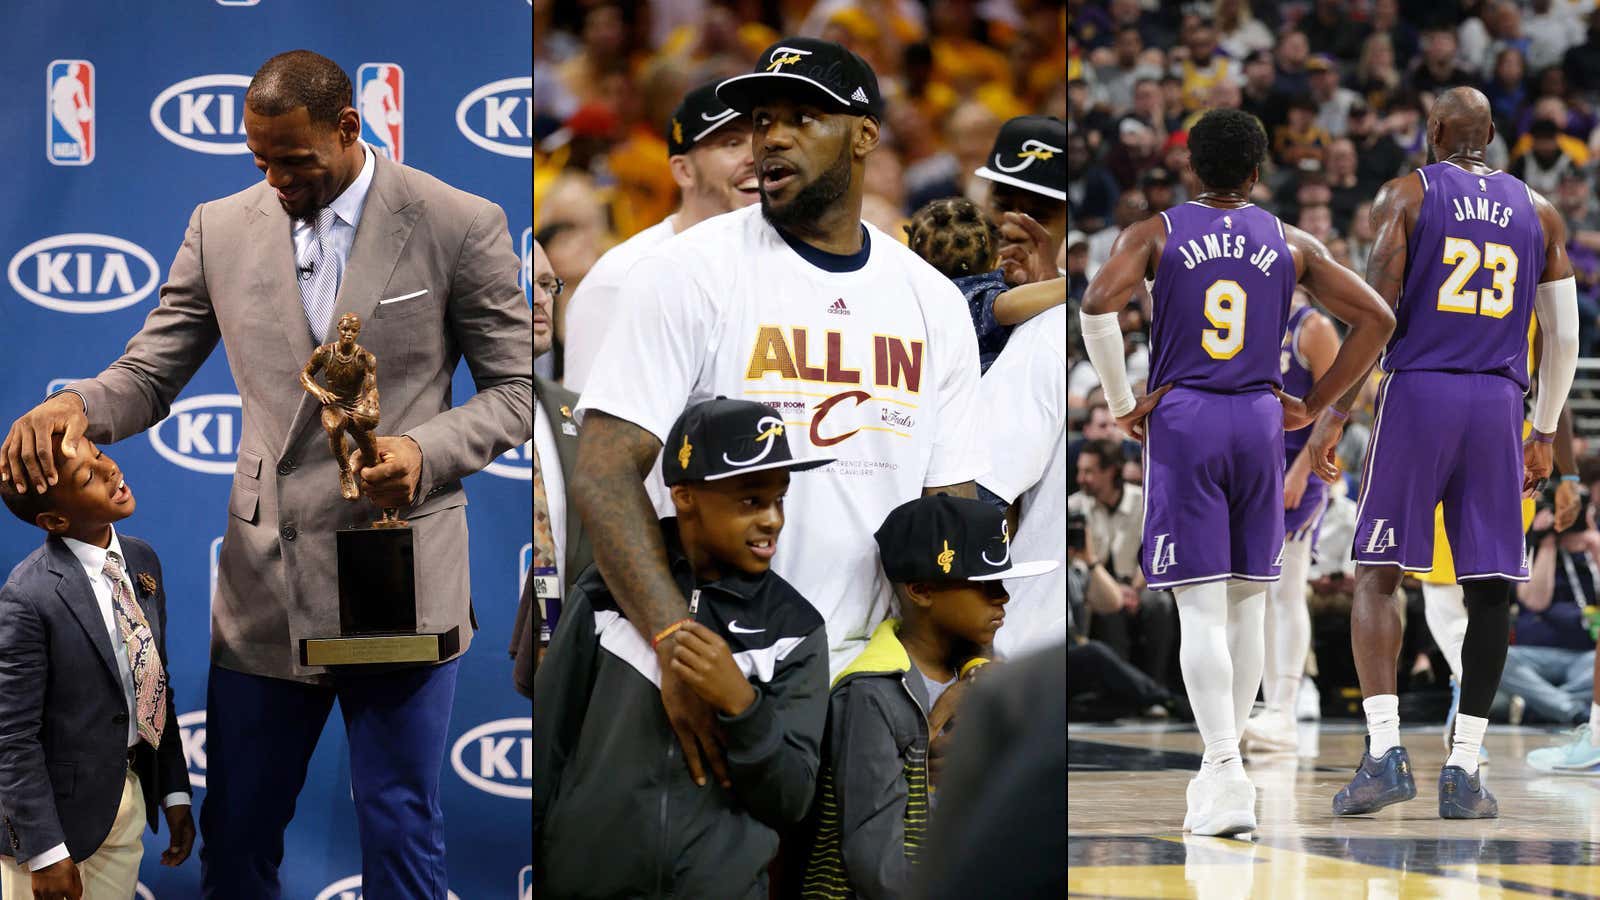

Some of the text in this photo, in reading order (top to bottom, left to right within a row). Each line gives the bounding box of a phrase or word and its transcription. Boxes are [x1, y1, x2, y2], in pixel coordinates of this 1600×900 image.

[178, 94, 247, 135] KI
[1453, 196, 1513, 228] JAMES
[36, 252, 136, 294] KIA
[1178, 233, 1278, 277] JAMES JR.
[1437, 236, 1519, 319] 23
[1201, 279, 1247, 360] 9
[744, 323, 926, 395] ALL IN
[177, 413, 241, 454] KI
[1151, 533, 1179, 575] LA
[1362, 518, 1398, 554] LA
